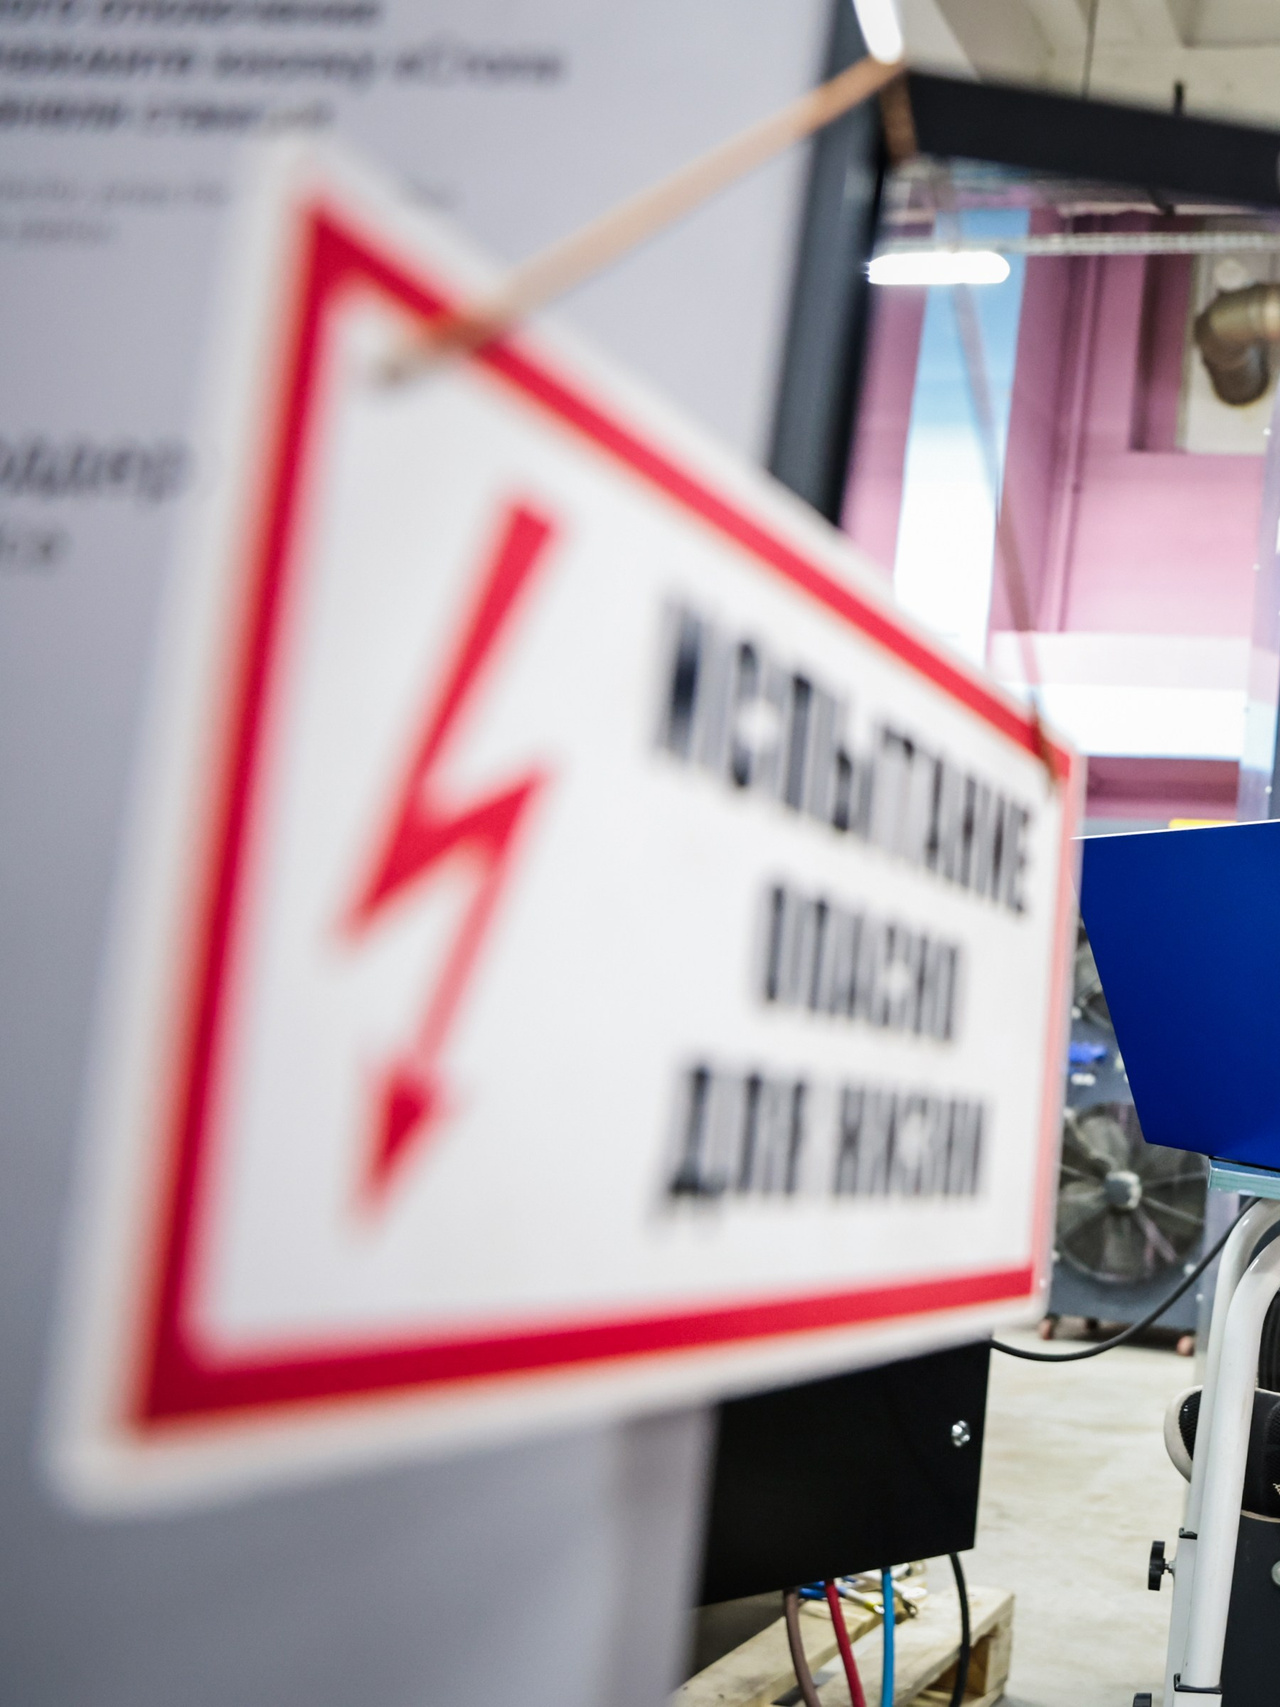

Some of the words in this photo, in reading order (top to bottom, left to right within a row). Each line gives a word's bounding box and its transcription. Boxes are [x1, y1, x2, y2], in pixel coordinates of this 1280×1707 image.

[656, 592, 1034, 918] ИСПЫТАНИЕ
[754, 878, 962, 1044] ОПАСНО
[660, 1058, 808, 1228] ДЛЯ
[828, 1080, 986, 1203] ЖИЗНИ
